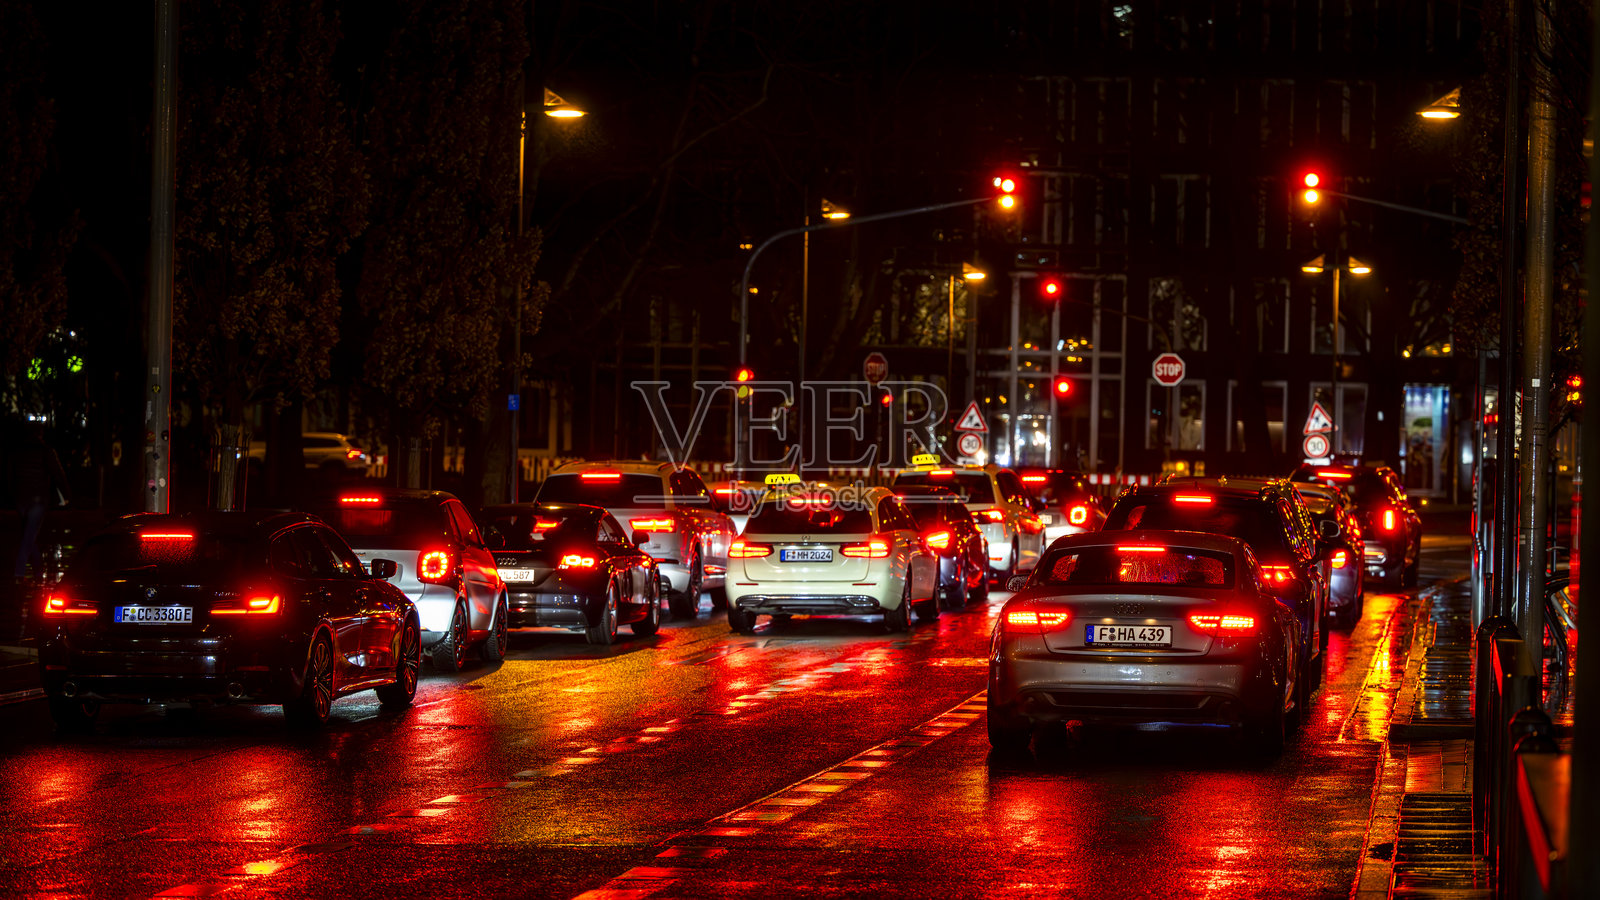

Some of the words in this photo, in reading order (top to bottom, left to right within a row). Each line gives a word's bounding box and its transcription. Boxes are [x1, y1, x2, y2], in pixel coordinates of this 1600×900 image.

[1156, 362, 1182, 377] STOP
[1310, 440, 1324, 452] 30
[786, 551, 792, 560] F
[797, 551, 809, 560] MH
[810, 551, 831, 560] 2024
[122, 608, 130, 621] F
[137, 608, 152, 621] CC
[1099, 627, 1109, 641] F
[1117, 627, 1136, 641] HA
[1138, 628, 1165, 642] 439
